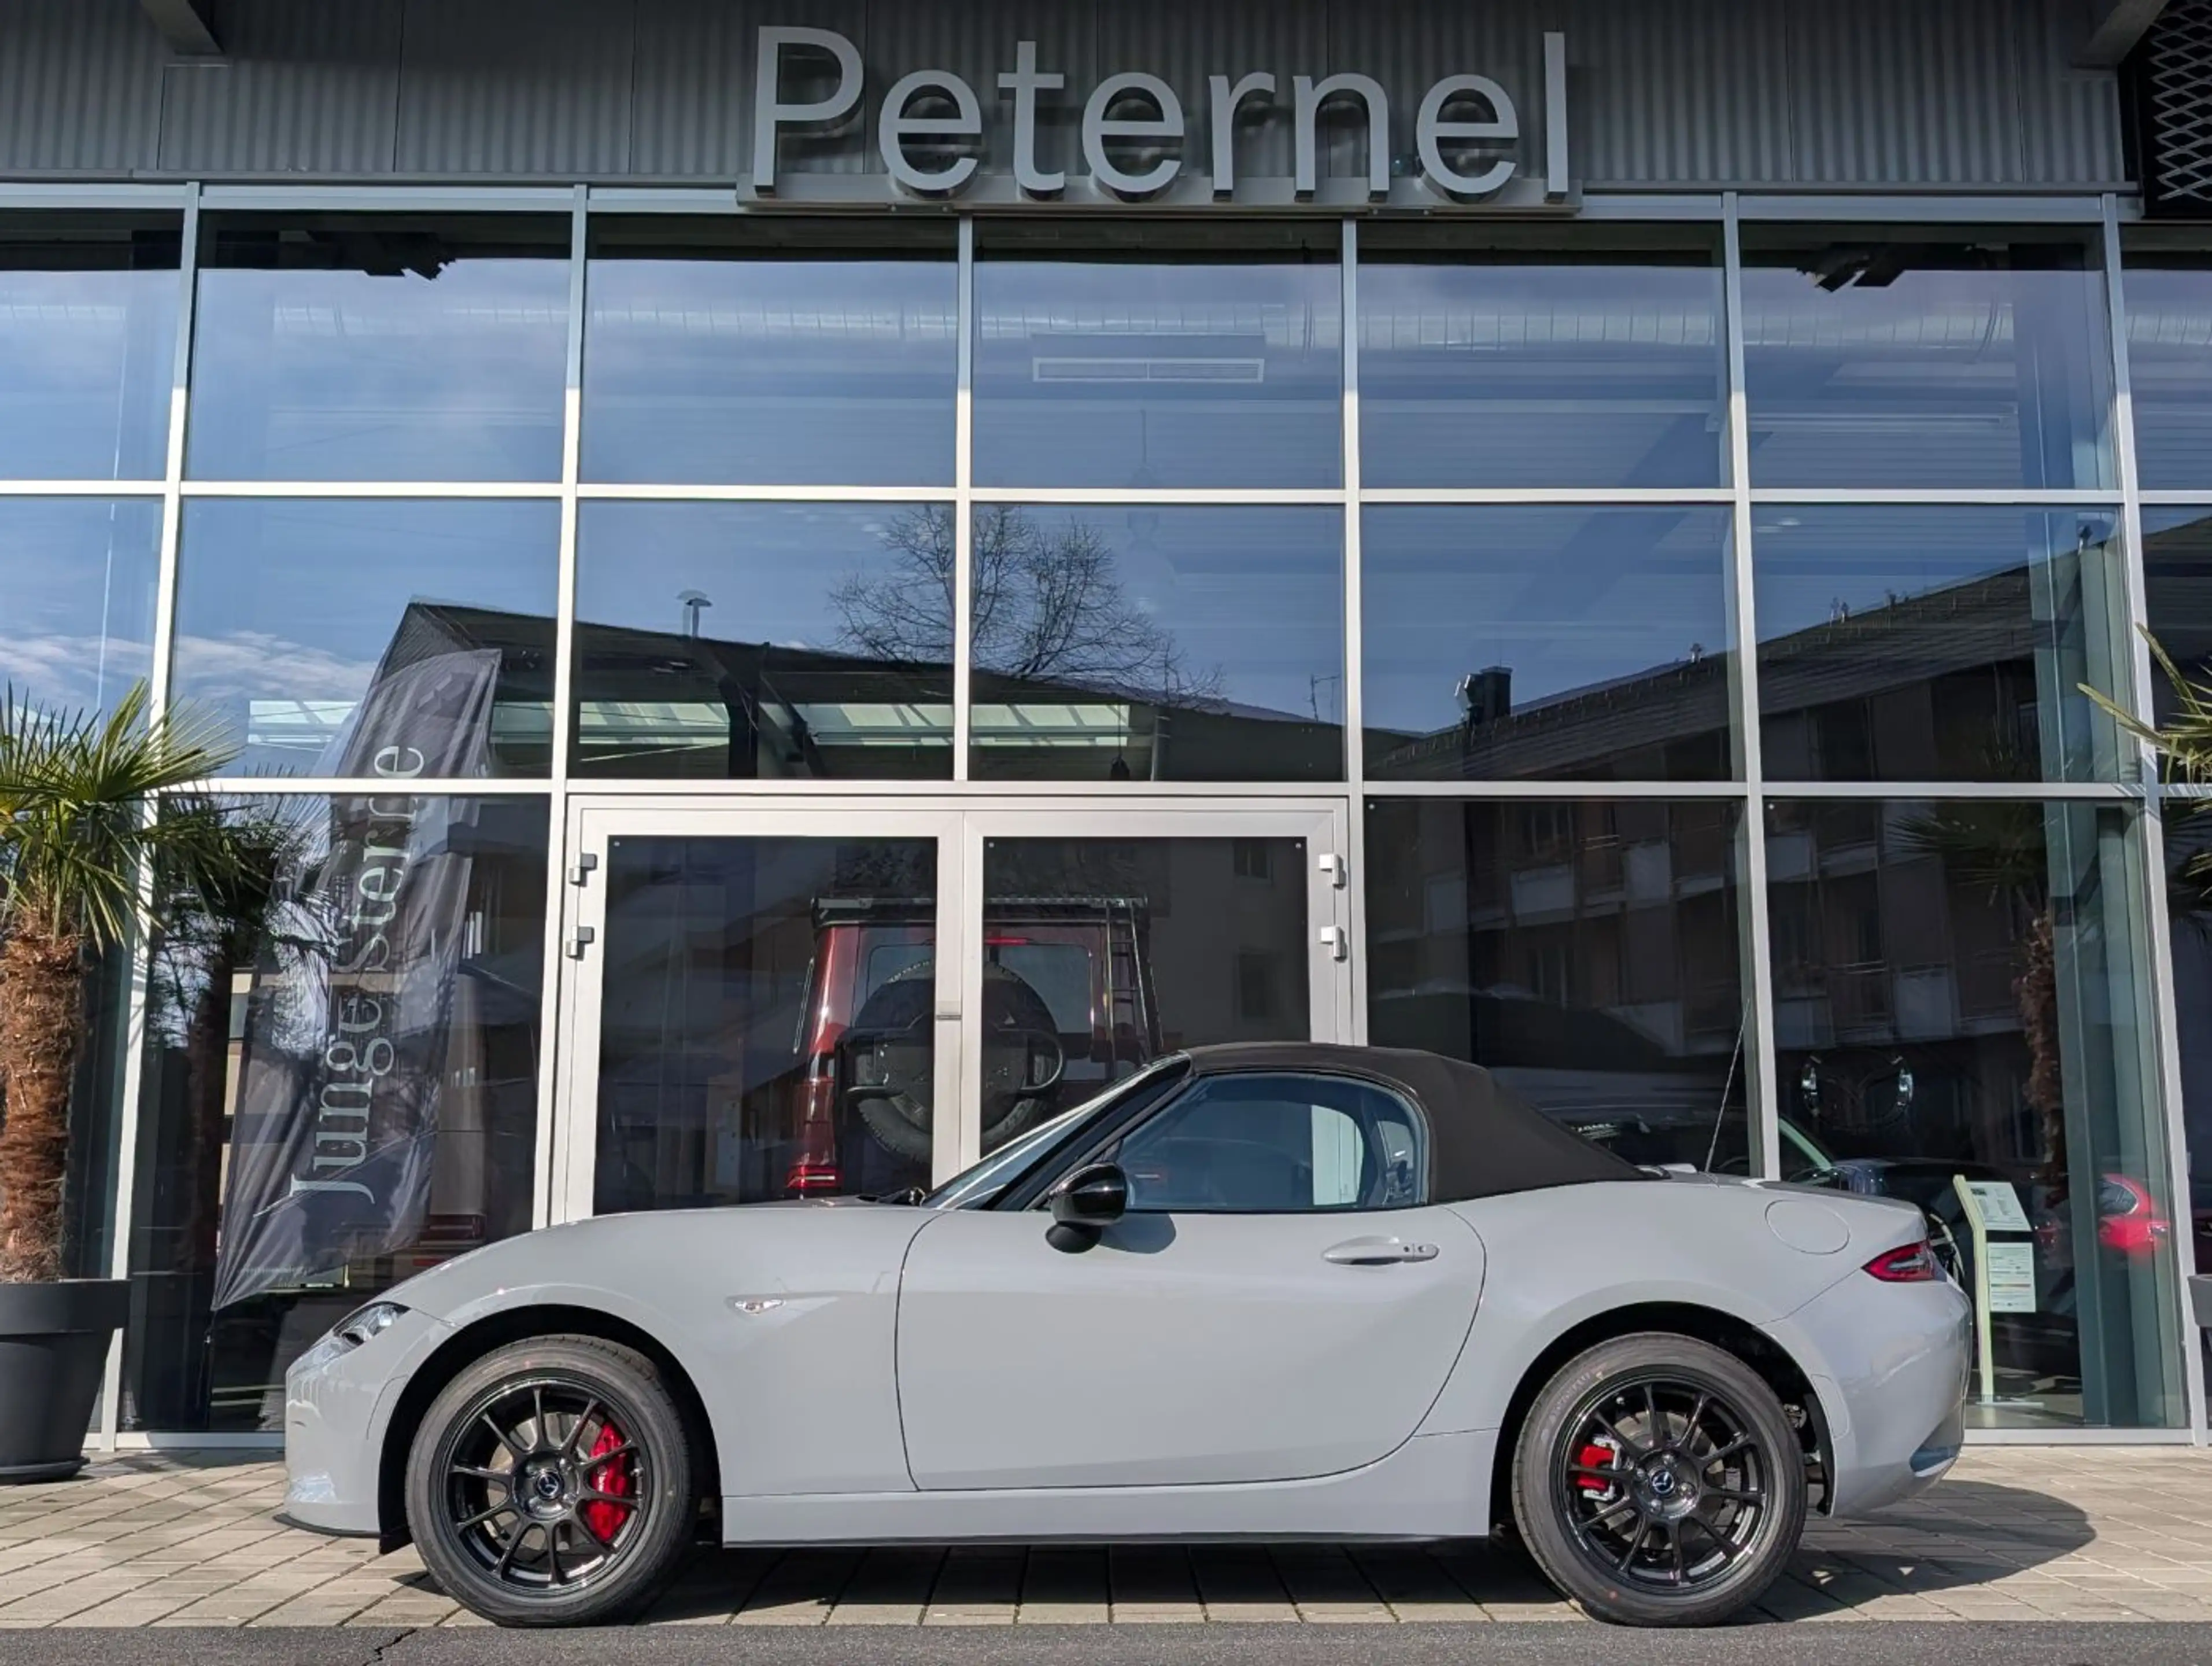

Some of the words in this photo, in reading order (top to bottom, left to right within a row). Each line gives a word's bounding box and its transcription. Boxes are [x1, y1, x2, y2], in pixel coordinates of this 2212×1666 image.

[752, 25, 1569, 197] Peternel
[330, 745, 424, 973] Sterne
[289, 997, 394, 1204] Junge
